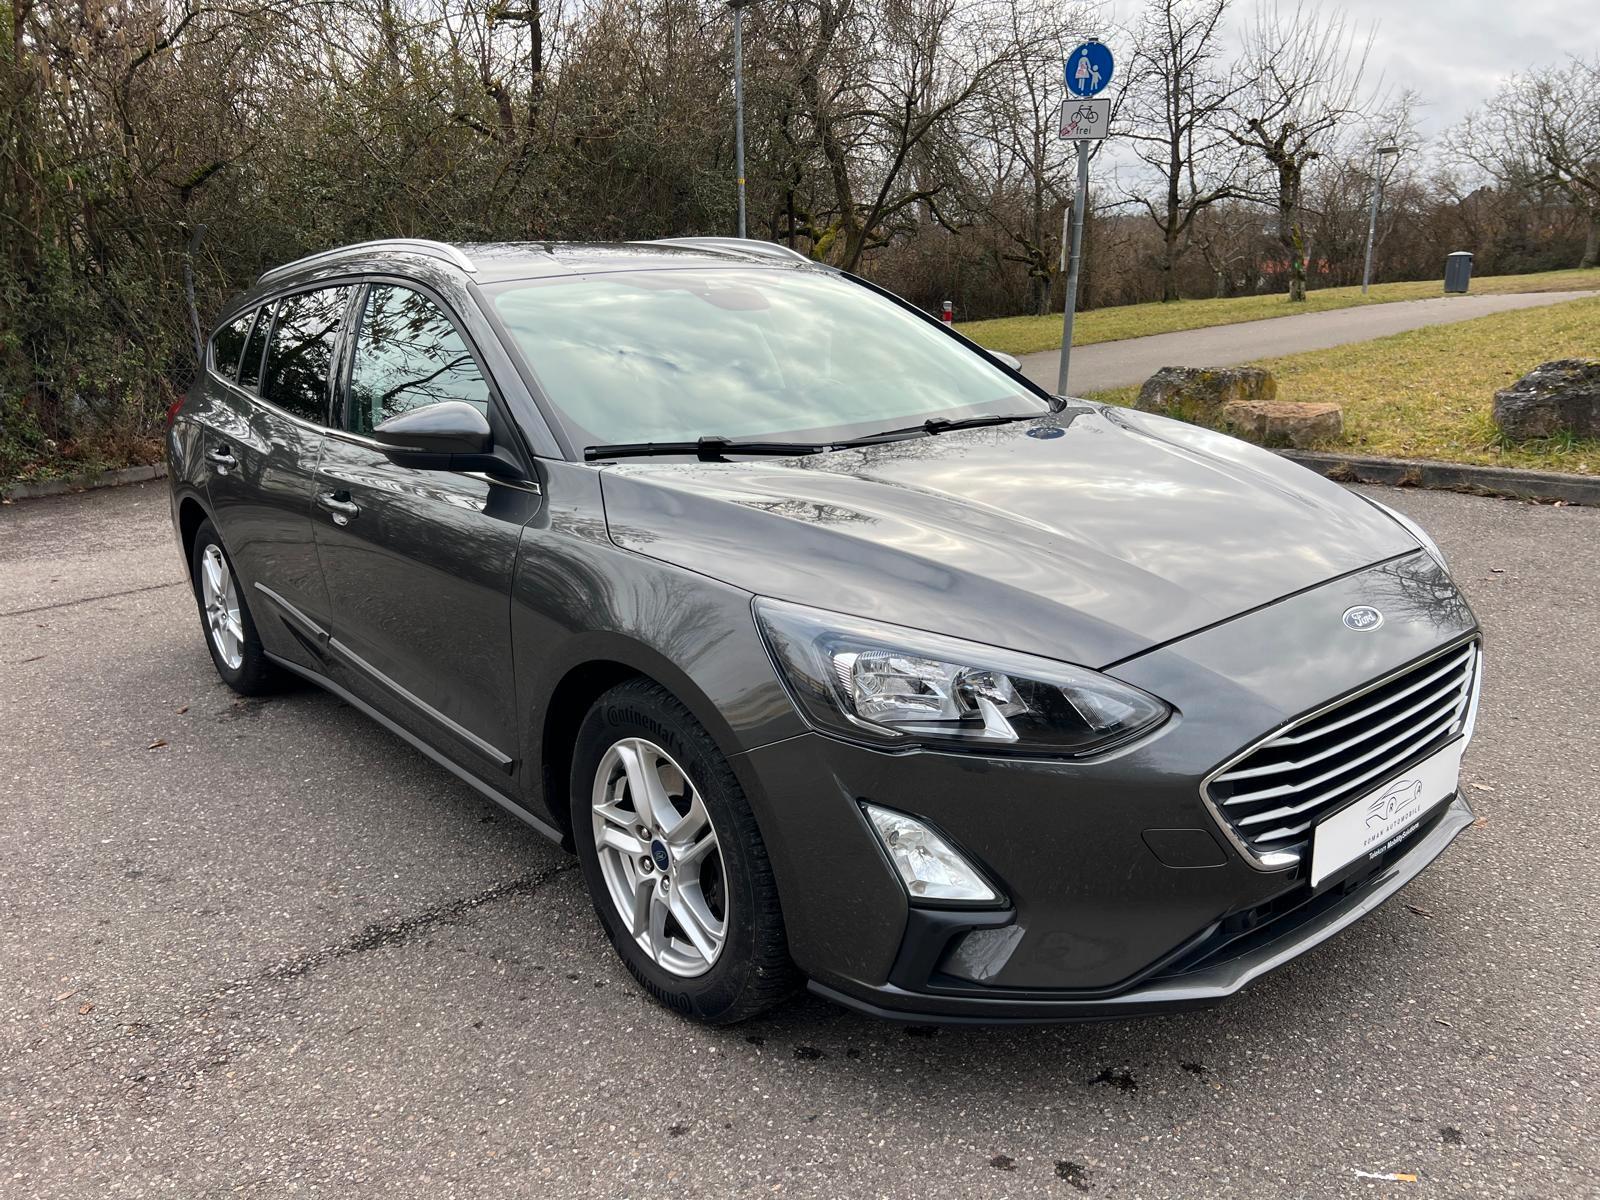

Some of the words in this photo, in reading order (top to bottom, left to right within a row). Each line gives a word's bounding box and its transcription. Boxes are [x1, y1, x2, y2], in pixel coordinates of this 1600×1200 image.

[1076, 125, 1091, 134] frei
[1351, 611, 1376, 627] Ford
[607, 705, 675, 746] Continental
[1363, 830, 1384, 846] ROMAN
[1386, 804, 1421, 832] AUTOMOBILE
